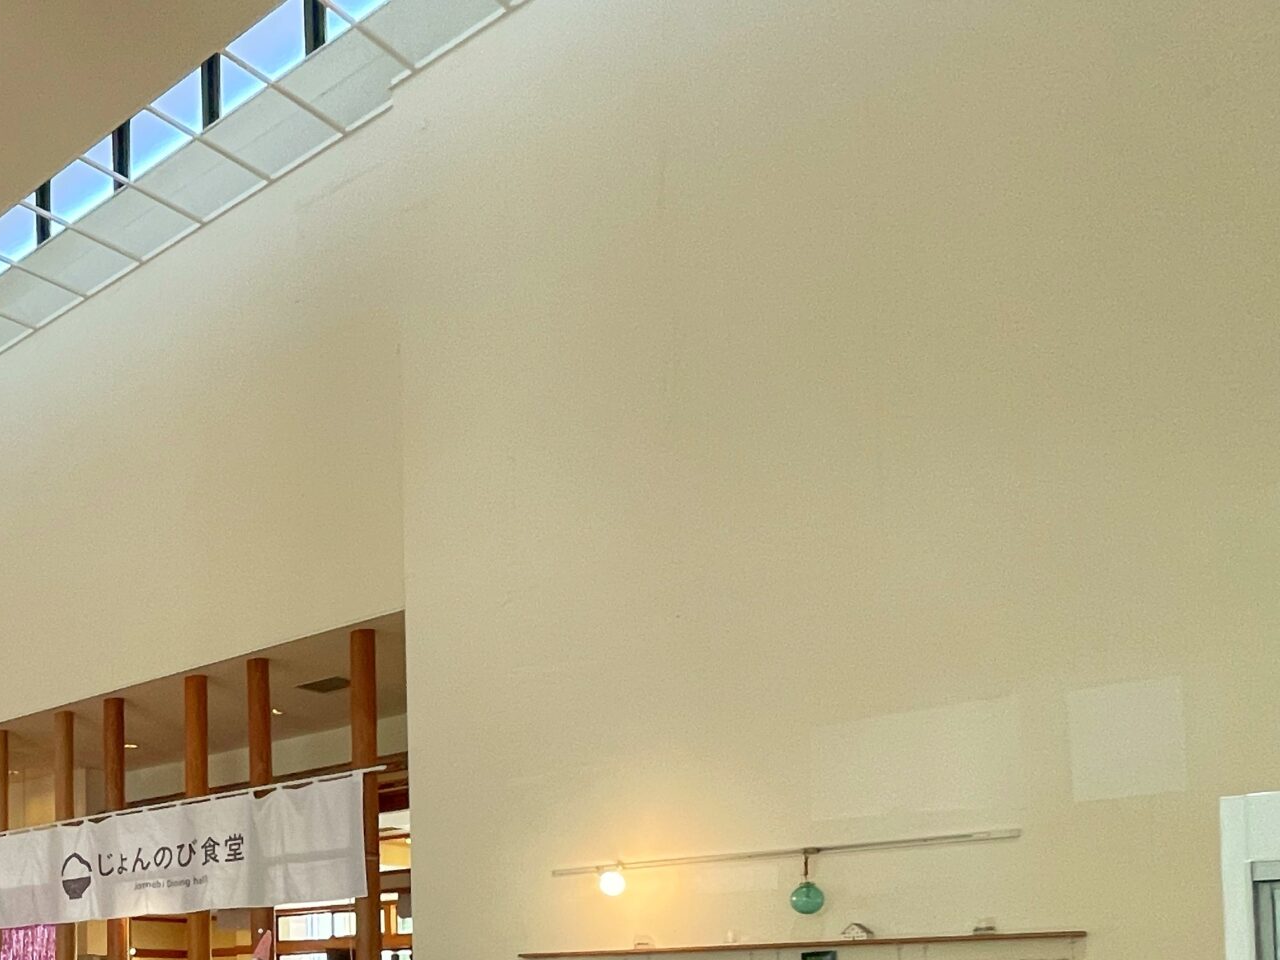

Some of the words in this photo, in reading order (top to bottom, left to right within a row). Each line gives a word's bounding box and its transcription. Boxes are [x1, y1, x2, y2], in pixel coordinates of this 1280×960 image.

[98, 834, 244, 876] じょんのび食堂
